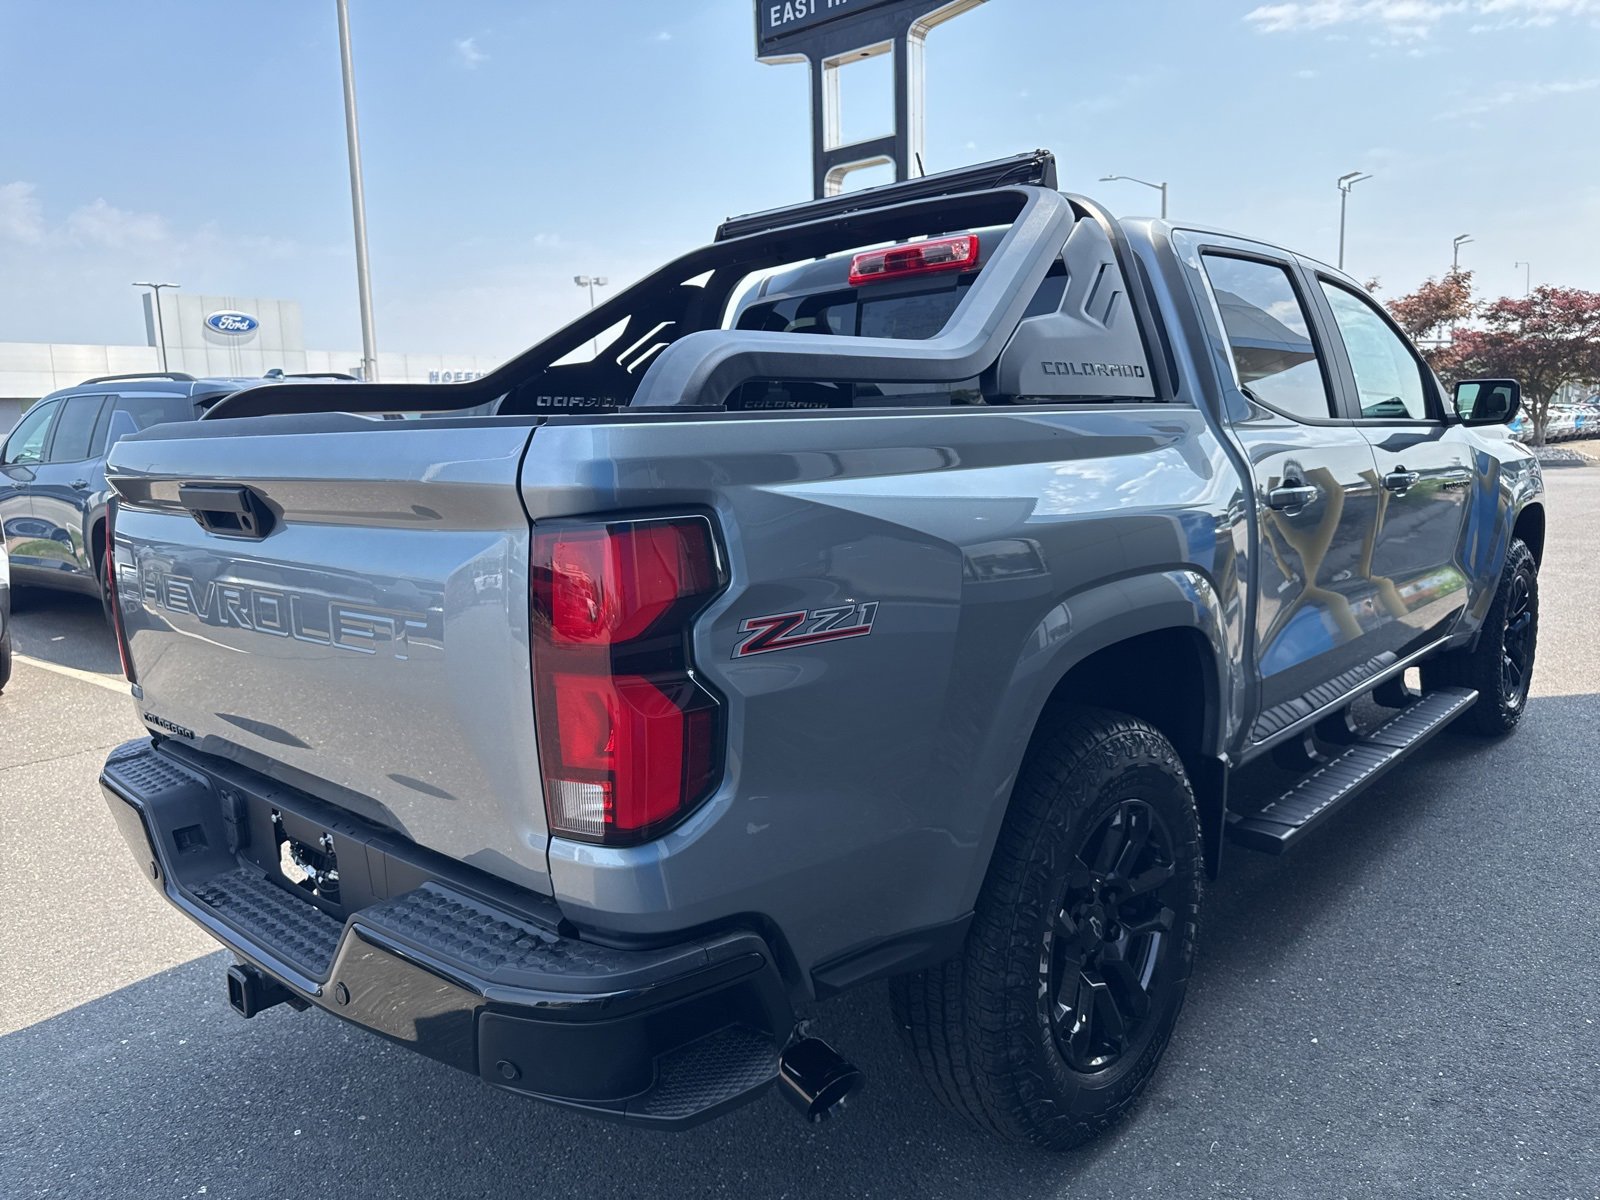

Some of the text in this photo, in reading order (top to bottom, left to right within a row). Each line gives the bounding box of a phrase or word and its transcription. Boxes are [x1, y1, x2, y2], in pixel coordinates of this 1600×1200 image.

[218, 315, 250, 330] Ford
[1041, 361, 1145, 378] COLORADO
[118, 562, 429, 661] CHEVROLET
[730, 600, 880, 660] Z71
